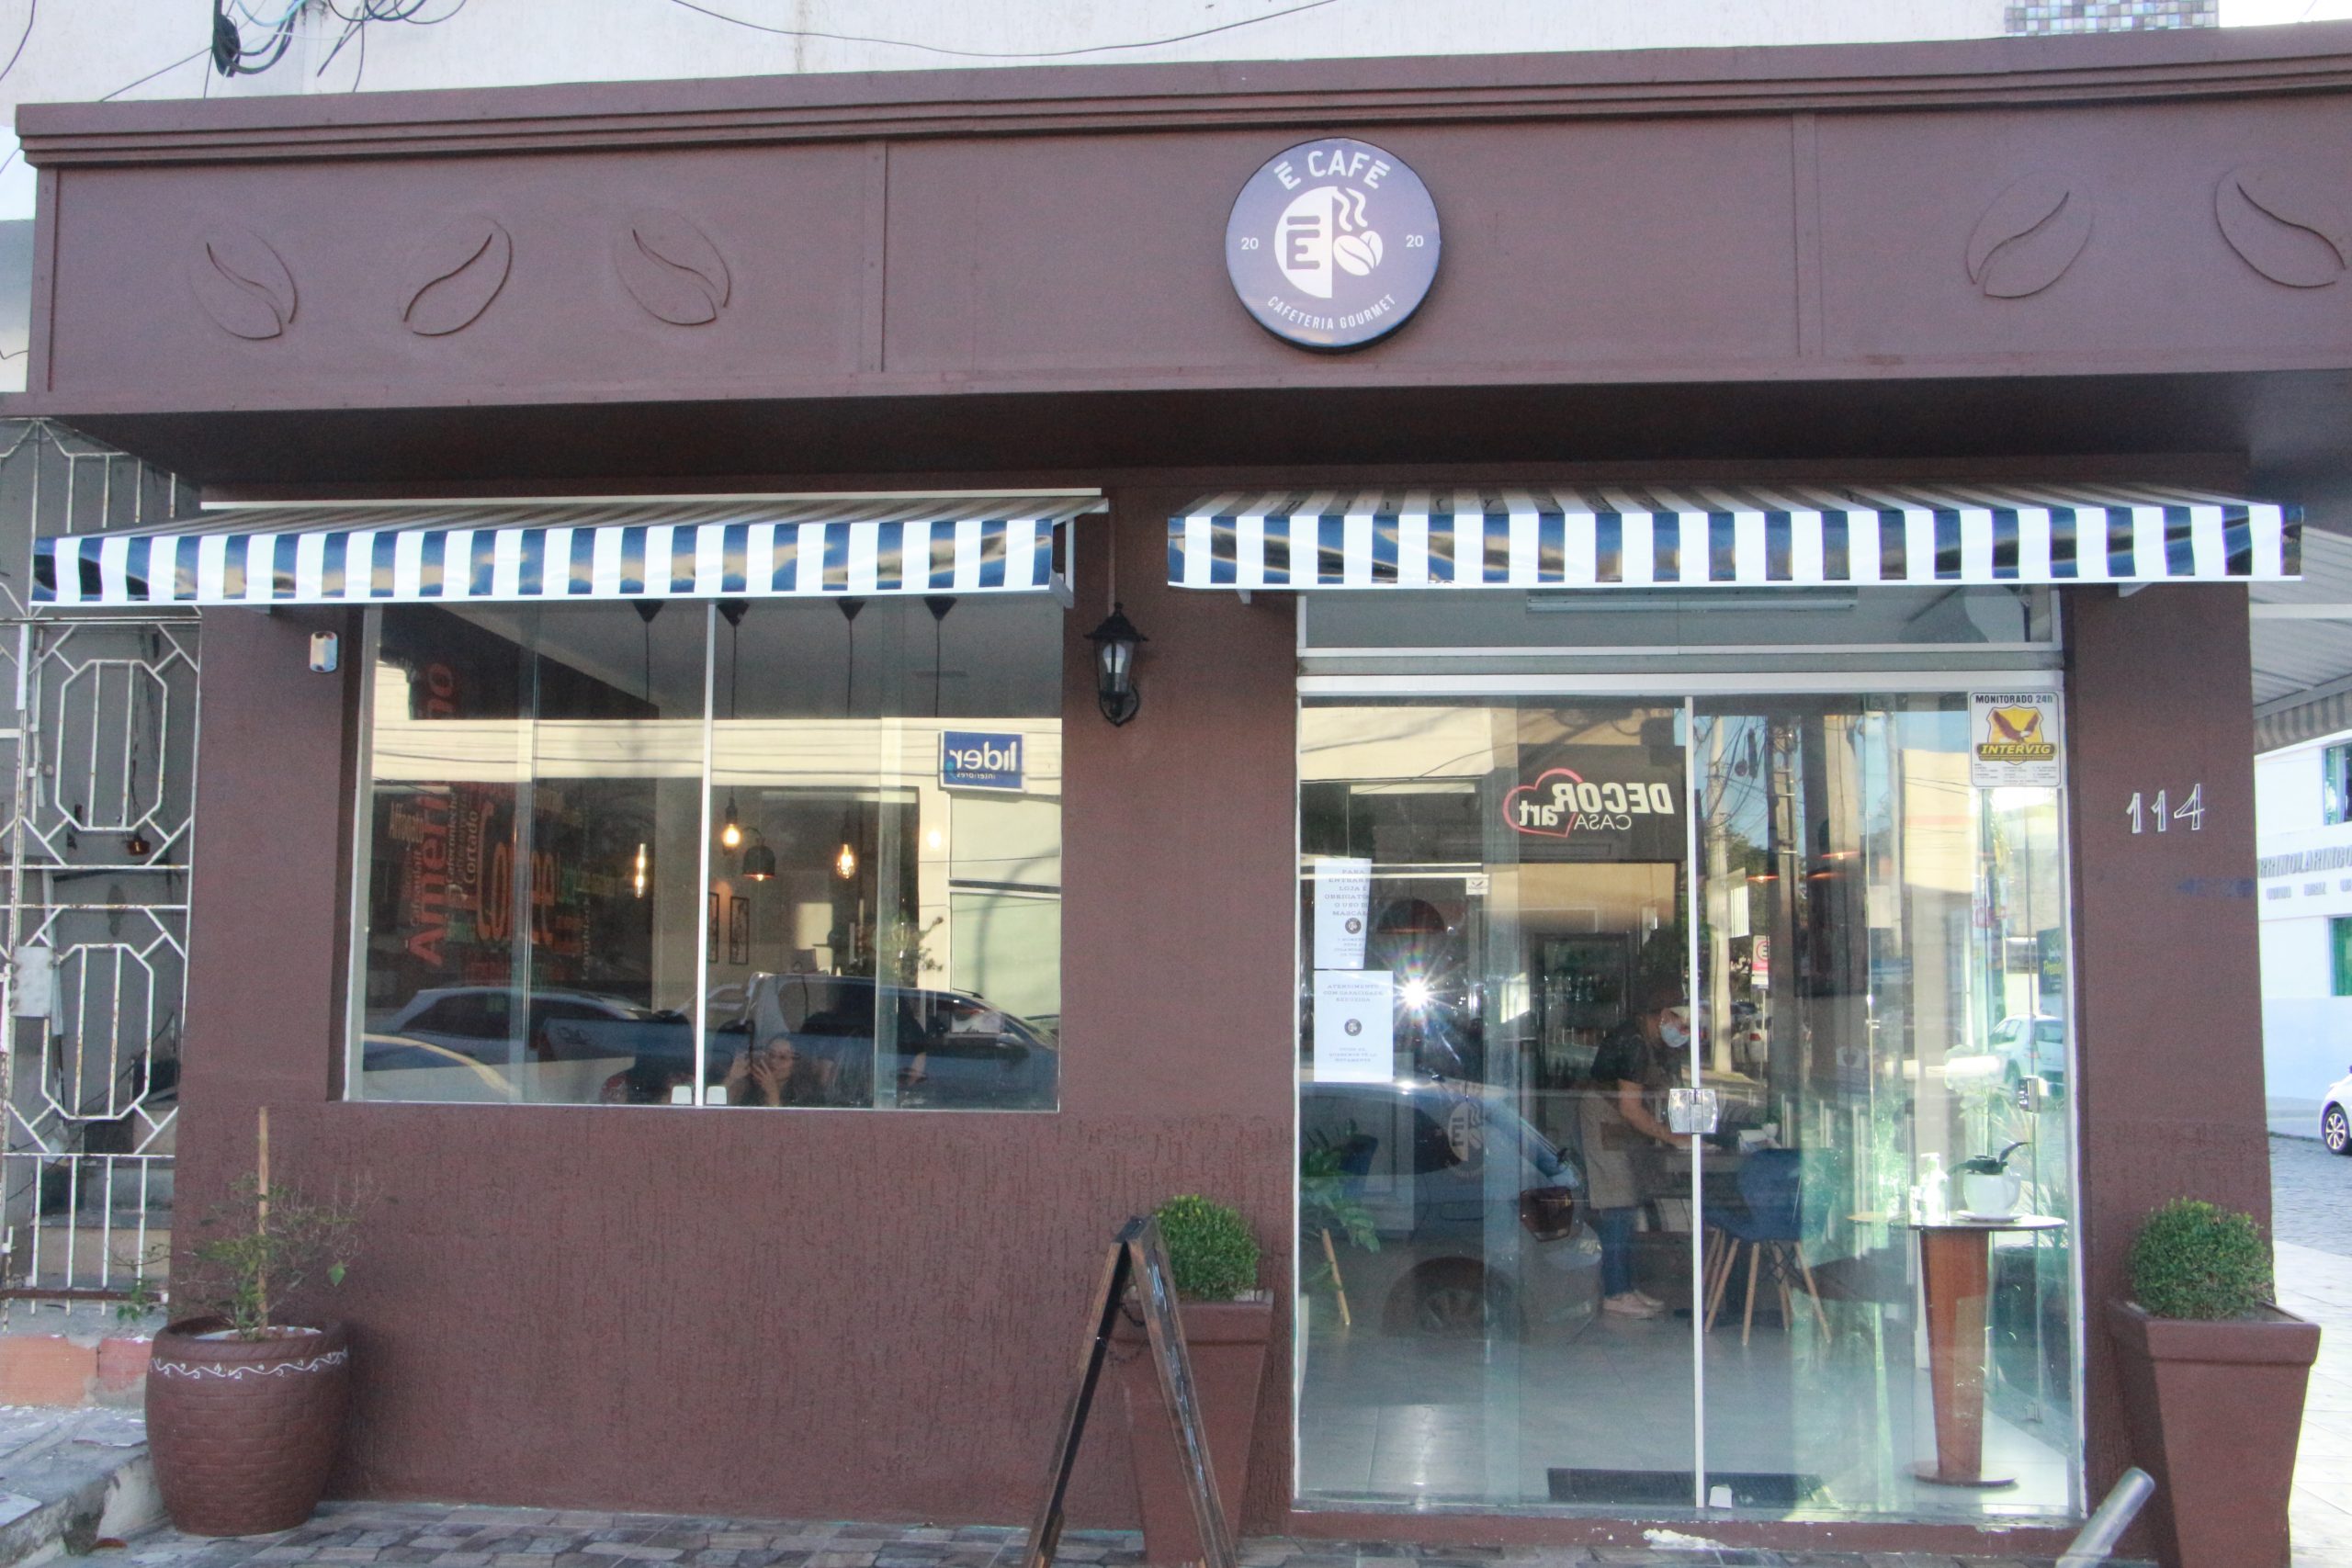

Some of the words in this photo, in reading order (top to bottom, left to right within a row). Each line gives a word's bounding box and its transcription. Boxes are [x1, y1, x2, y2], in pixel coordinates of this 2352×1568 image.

[1241, 238, 1259, 250] 20
[1406, 235, 1423, 247] 20
[1267, 295, 1334, 330] CAFETERIA
[1340, 293, 1396, 329] GOURMET
[1975, 694, 2033, 704] MONITORADO
[1981, 744, 2052, 754] INTERVIG
[2126, 783, 2205, 834] 114
[463, 810, 479, 884] Cortado
